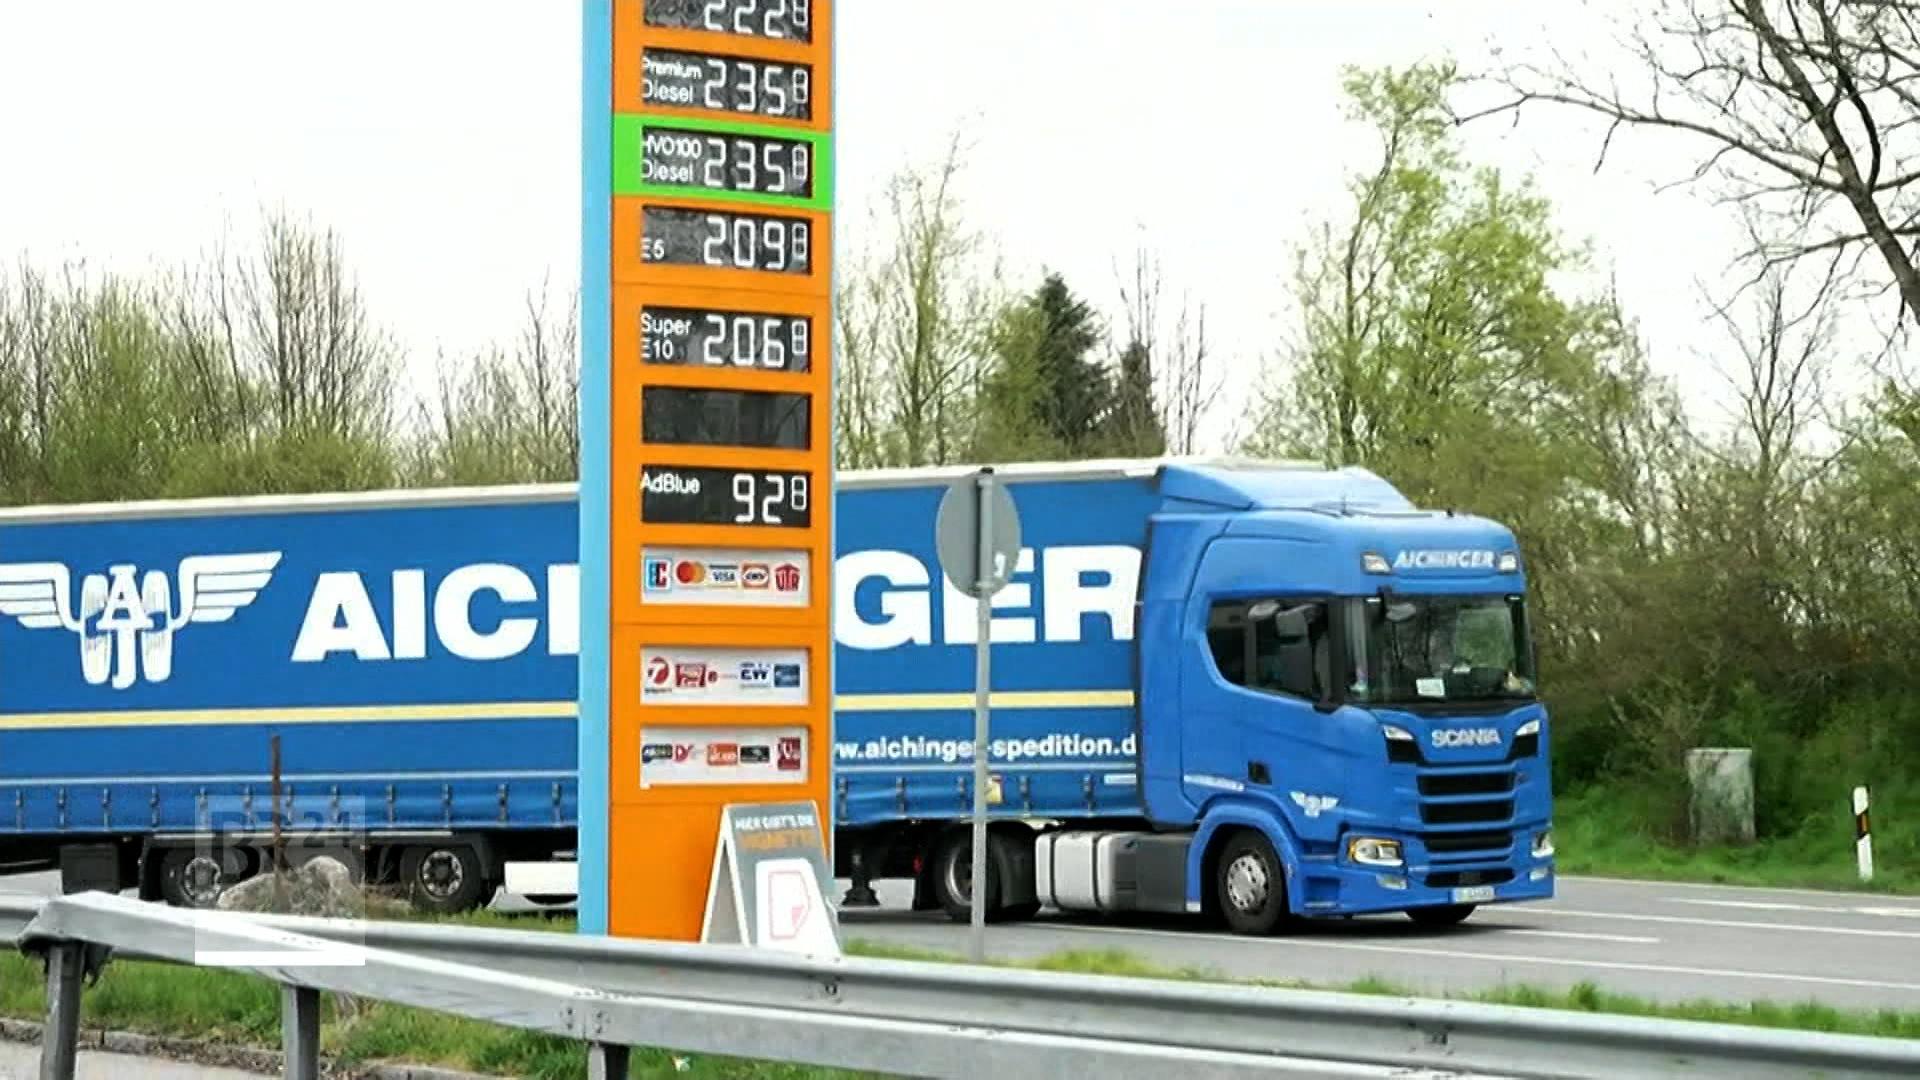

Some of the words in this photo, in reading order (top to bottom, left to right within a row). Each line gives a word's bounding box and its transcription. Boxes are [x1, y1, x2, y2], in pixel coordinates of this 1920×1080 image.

[641, 56, 702, 80] Premium
[641, 79, 693, 103] Diesel
[641, 159, 693, 182] Diesel
[640, 312, 692, 337] Super
[641, 337, 673, 360] E10
[640, 472, 700, 495] AdBlue
[1431, 728, 1502, 749] SCANIA
